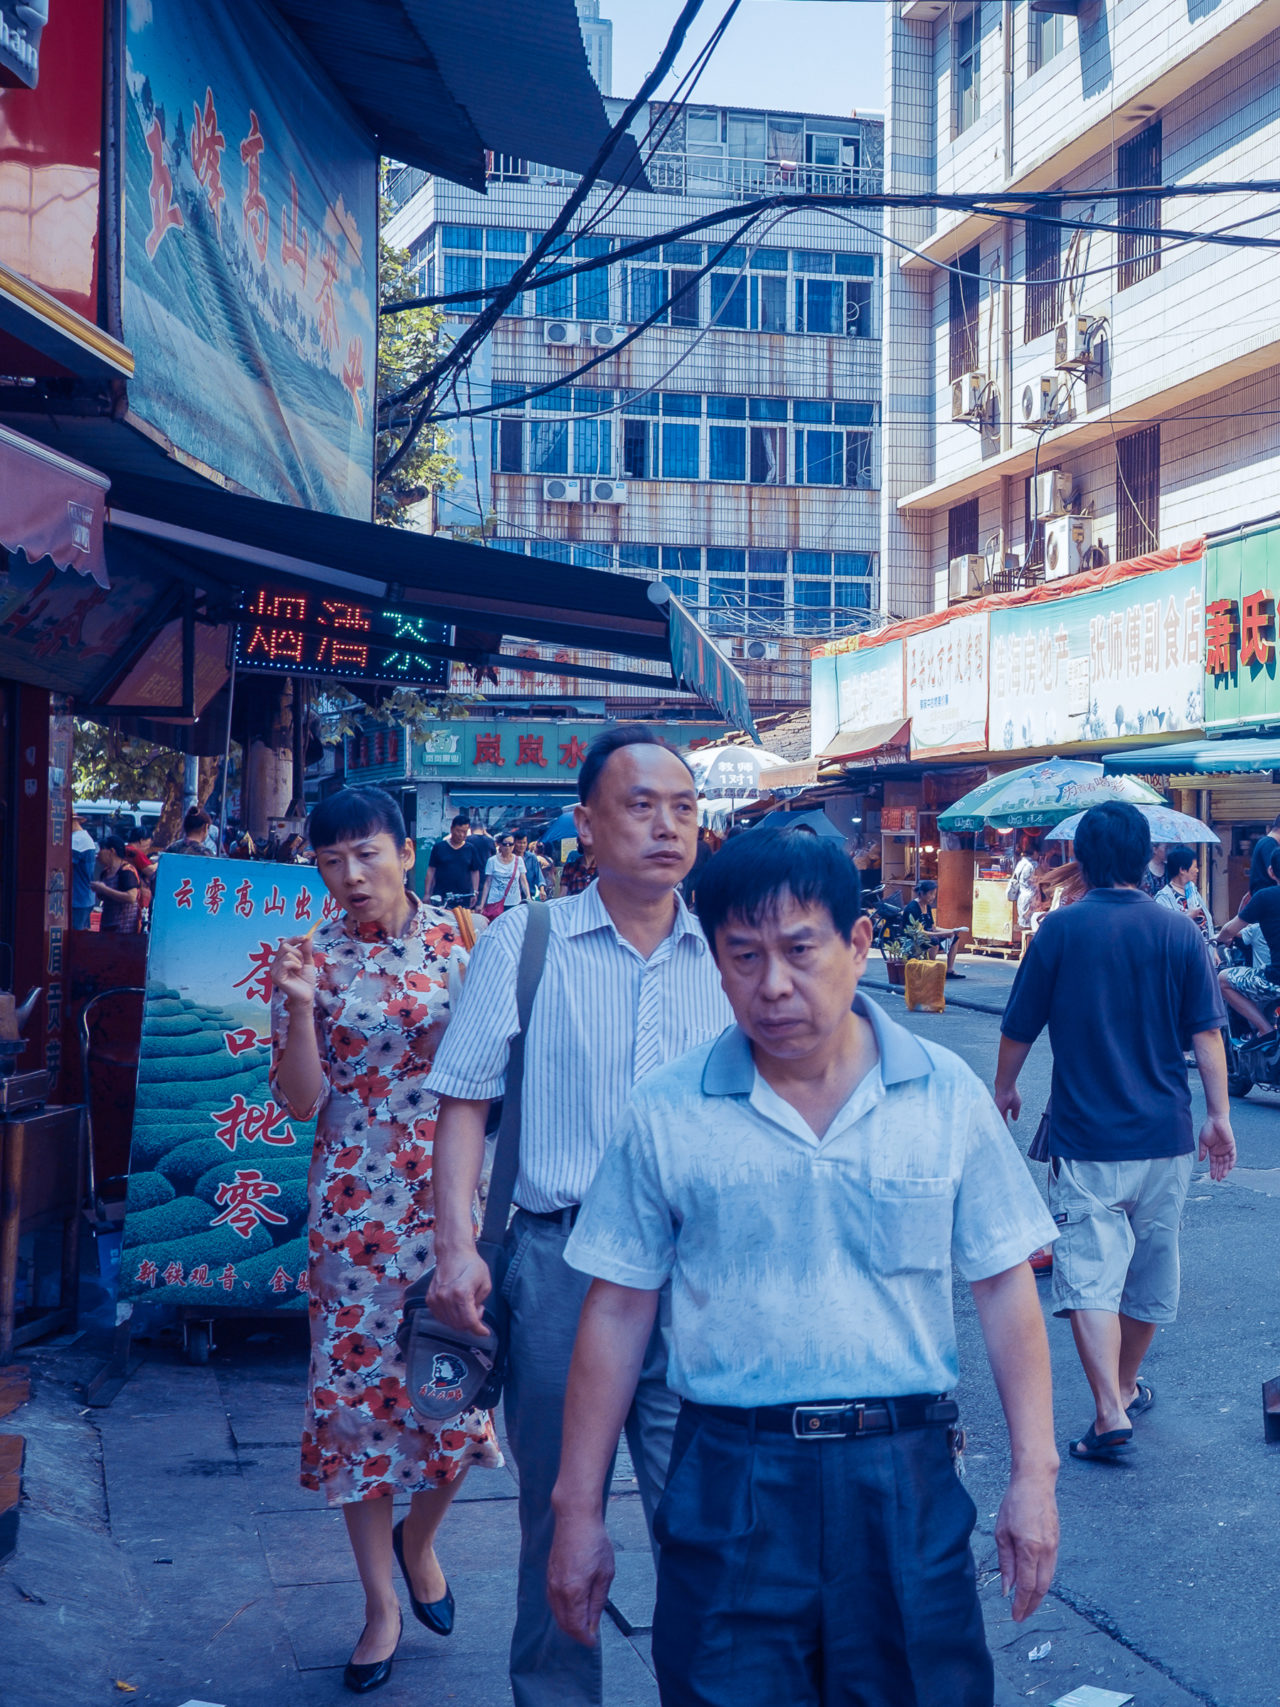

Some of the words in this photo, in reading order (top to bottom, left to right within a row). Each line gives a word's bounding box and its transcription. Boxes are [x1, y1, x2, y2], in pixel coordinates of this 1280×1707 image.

[1089, 585, 1204, 684] 张师傅副食店
[717, 761, 754, 772] 教师
[719, 774, 754, 785] 1对1
[173, 876, 343, 922] 云雾高山出好
